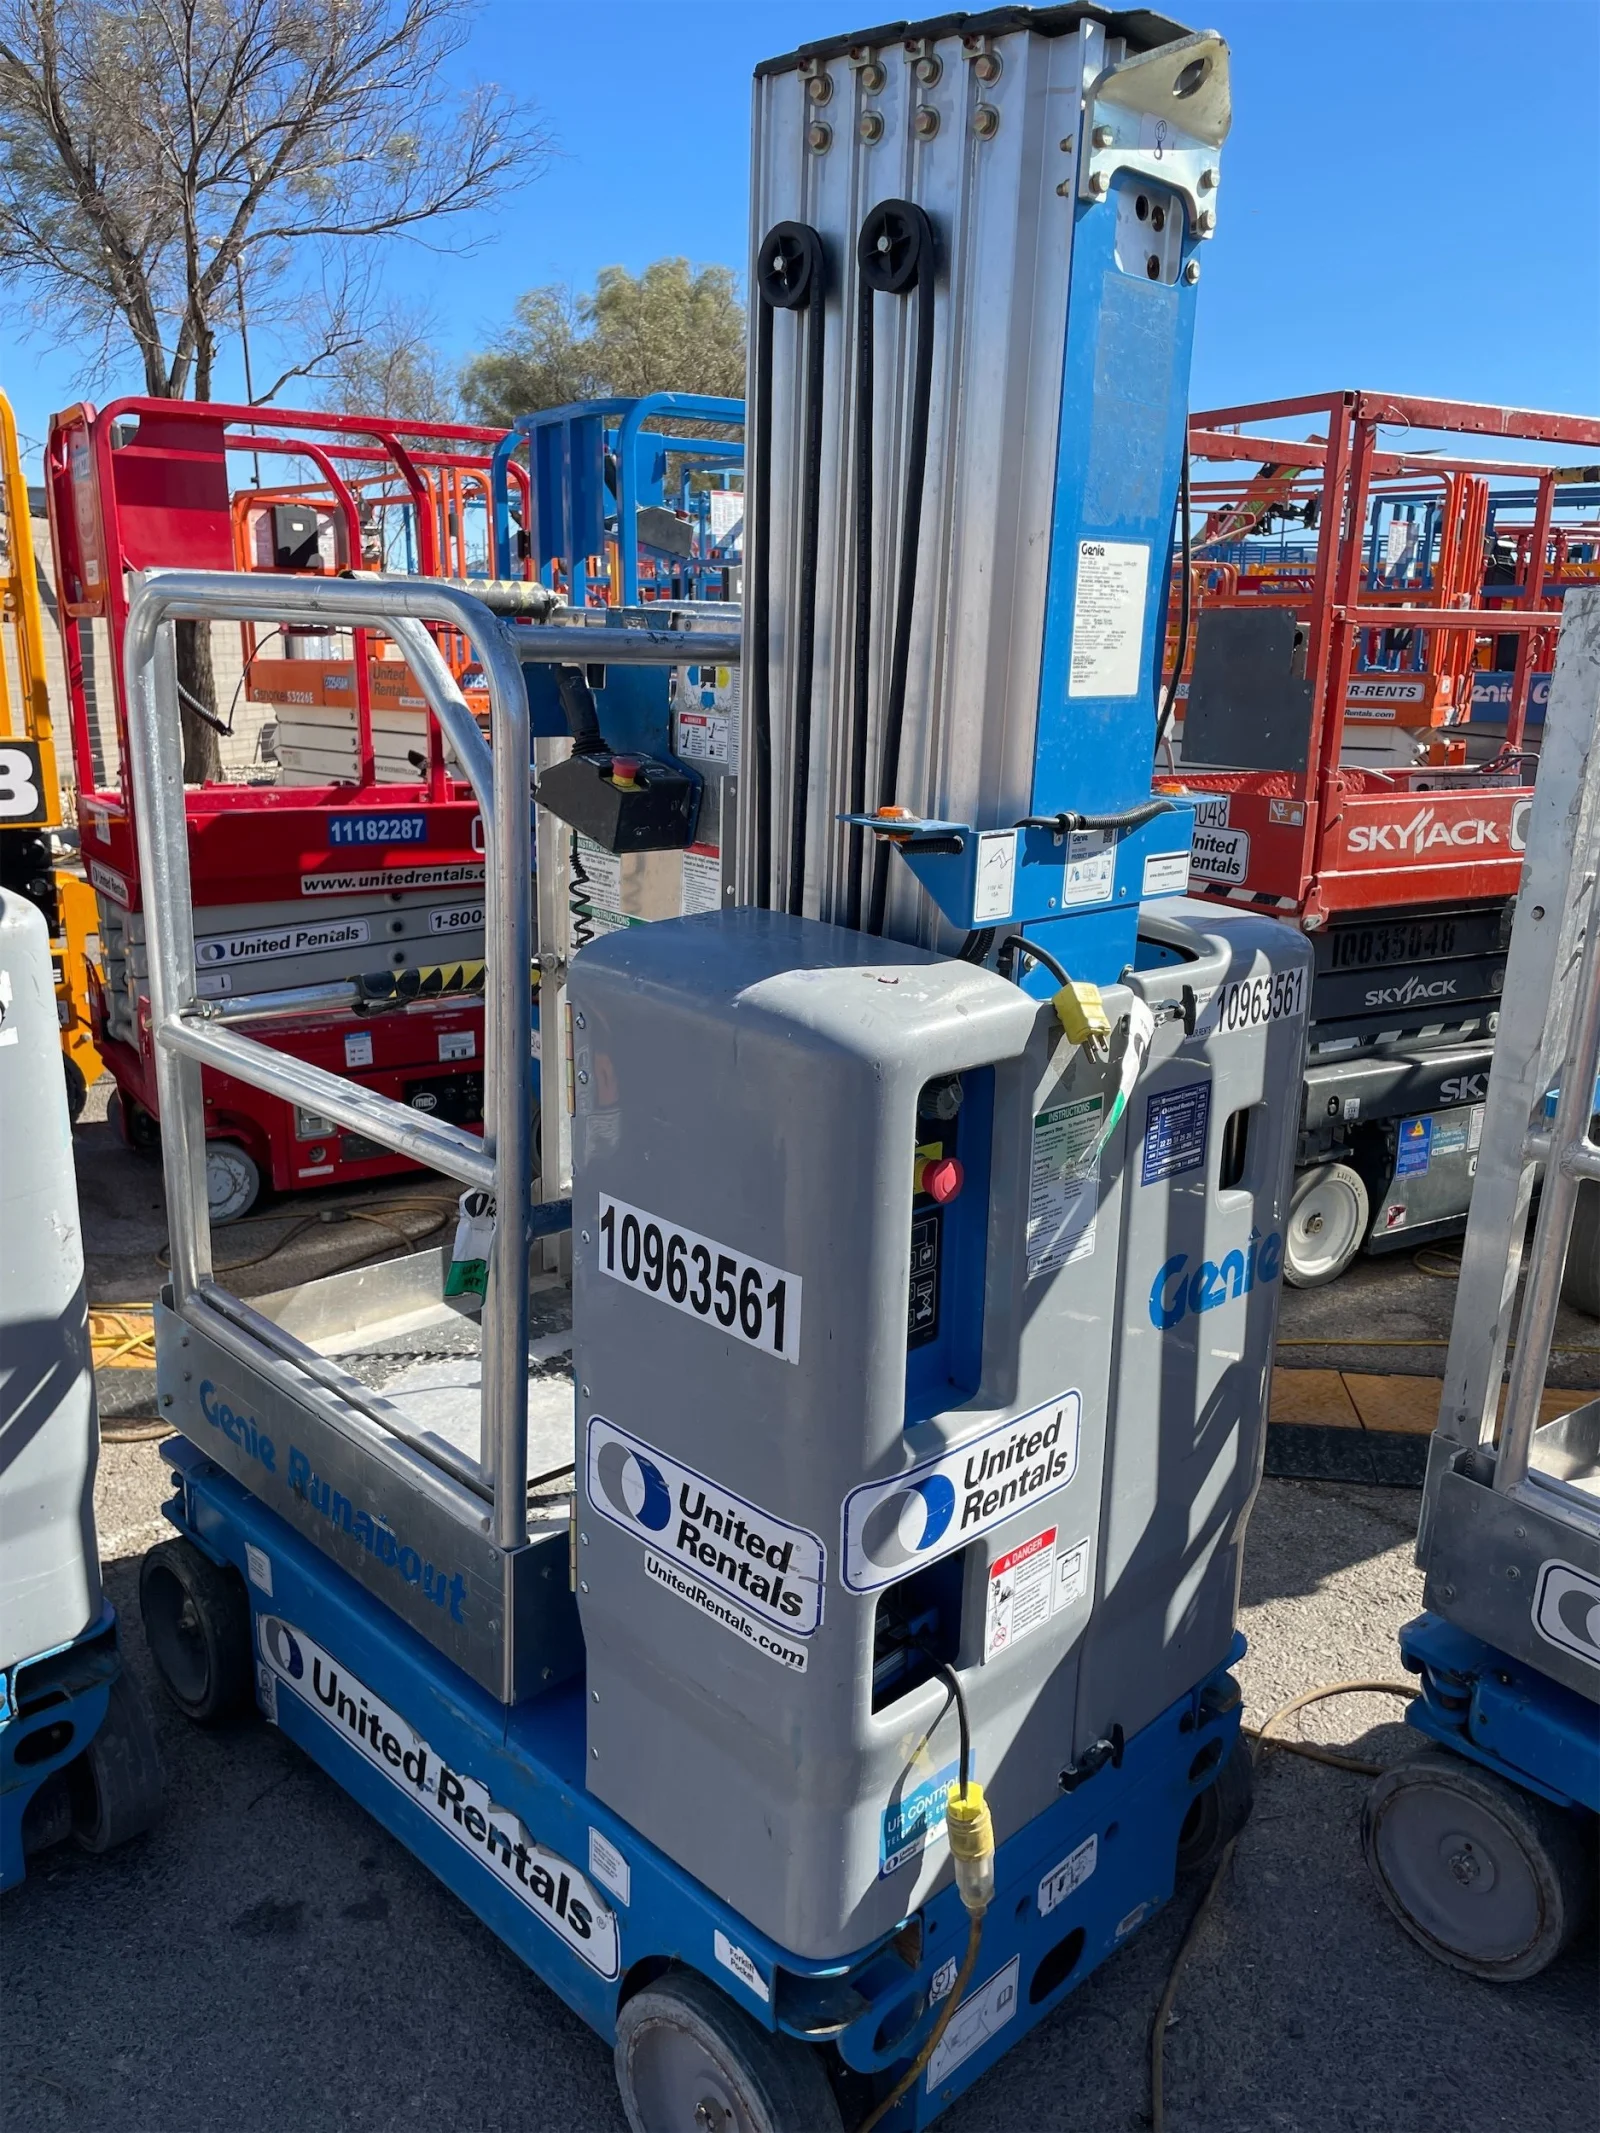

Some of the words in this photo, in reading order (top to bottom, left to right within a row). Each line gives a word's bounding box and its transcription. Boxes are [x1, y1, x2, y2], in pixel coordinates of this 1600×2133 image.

[1081, 543, 1105, 557] Genie
[373, 665, 406, 680] United
[374, 682, 409, 696] Rentals
[331, 818, 424, 842] 11182287
[1347, 806, 1499, 854] SKYJACK
[1191, 853, 1240, 876] entals
[230, 933, 290, 957] United
[1332, 922, 1456, 967] 10035048
[1217, 968, 1303, 1033] 10963561
[1365, 976, 1457, 1006] SKYJACK
[1048, 1102, 1090, 1122] INSTRUCTIONS
[601, 1205, 786, 1352] 10963561
[1149, 1225, 1281, 1330] Genie
[200, 1379, 276, 1474] Genie
[963, 1411, 1063, 1490] United
[960, 1451, 1068, 1530] Rentals
[287, 1445, 467, 1625] Runabout
[679, 1482, 793, 1573] United
[676, 1520, 803, 1617] Rentals
[1012, 1538, 1043, 1563] DANGER
[647, 1556, 805, 1666] UnitedRentals.com
[312, 1657, 428, 1787] United
[436, 1765, 593, 1939] Rentals
[888, 1814, 905, 1833] UR
[1041, 1862, 1069, 1890] Emergency
[729, 1947, 755, 1974] Forklift
[730, 1957, 754, 1984] Pocket
